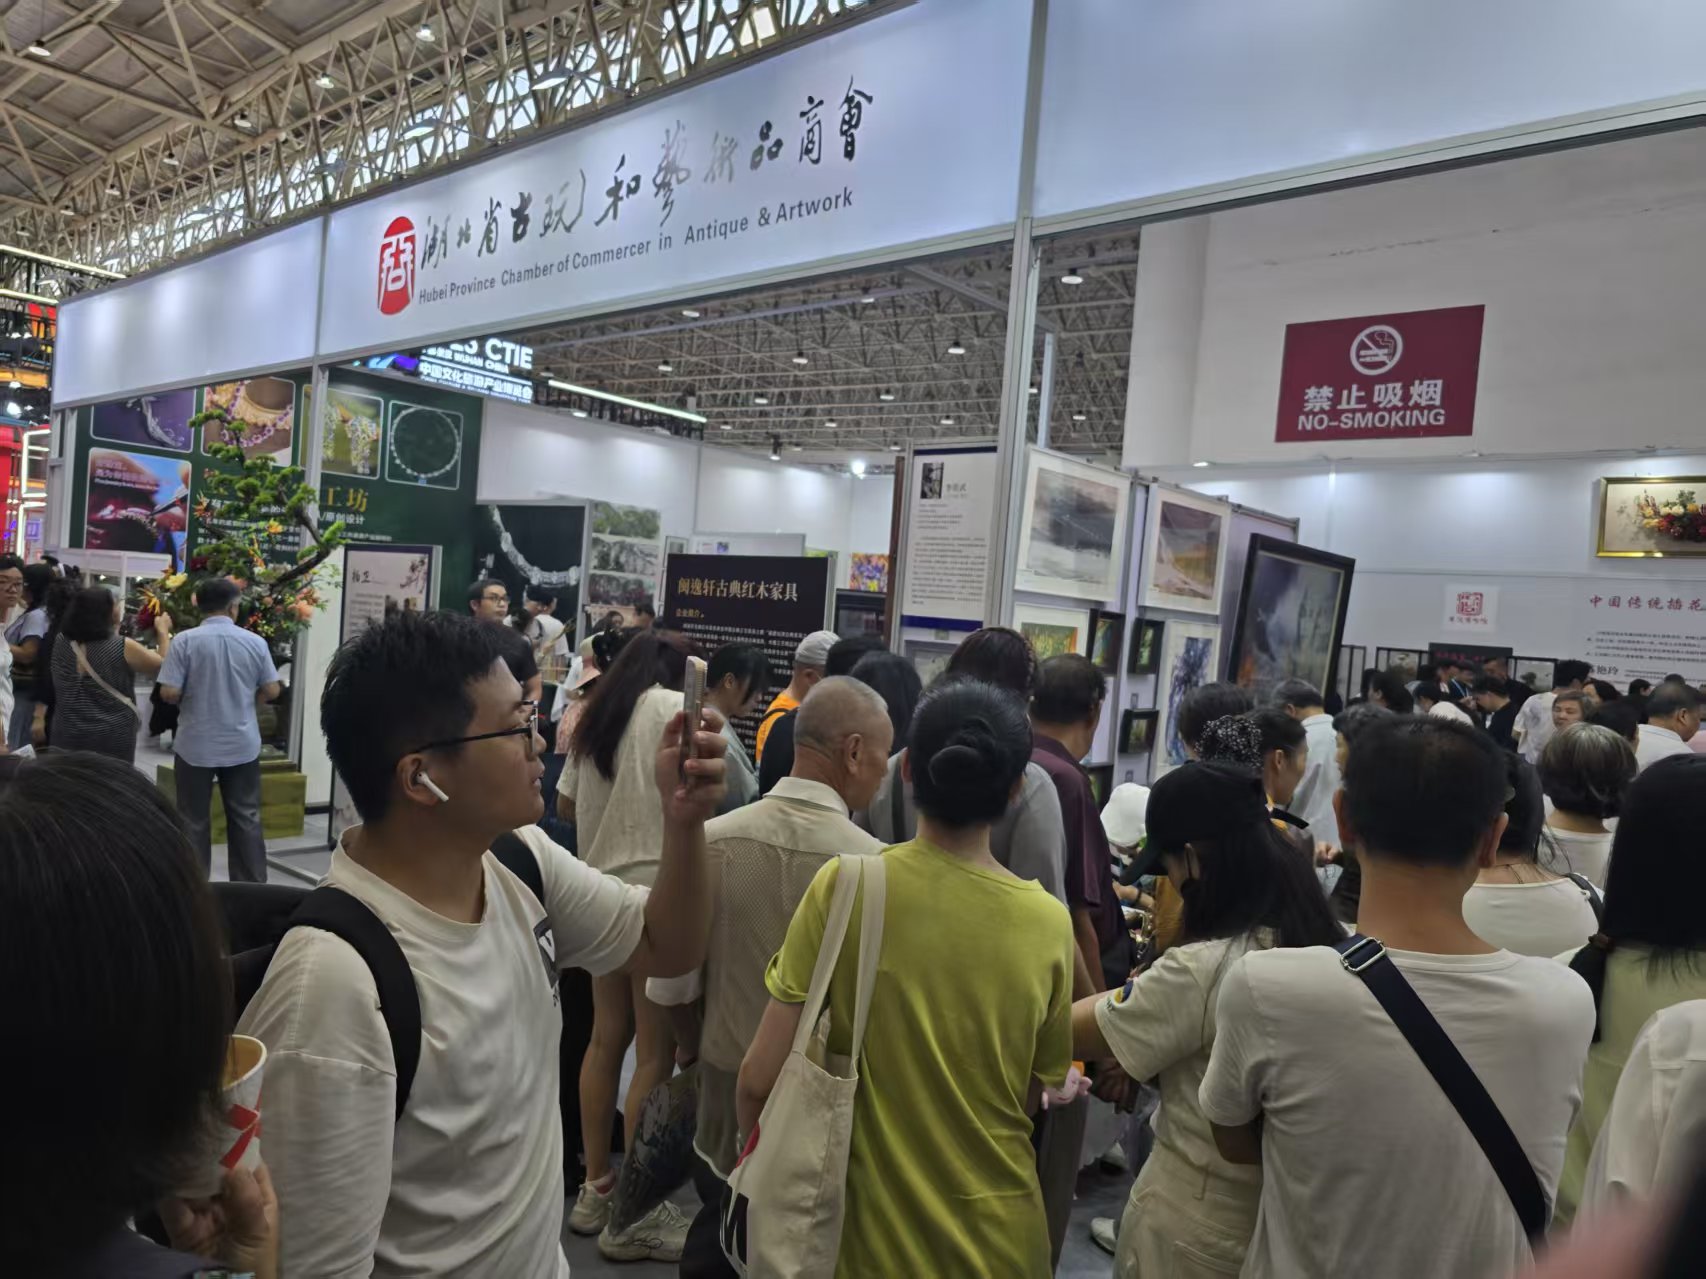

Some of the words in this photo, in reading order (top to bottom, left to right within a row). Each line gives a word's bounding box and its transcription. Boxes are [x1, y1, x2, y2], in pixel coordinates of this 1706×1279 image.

[419, 282, 448, 304] Hubei
[449, 276, 496, 297] Province
[501, 262, 554, 286] Chamber
[557, 254, 570, 273] of
[572, 241, 651, 270] Commercer
[658, 232, 673, 250] in
[684, 216, 749, 245] Antique
[758, 207, 771, 227] &
[775, 186, 854, 225] Artwork
[485, 337, 534, 369] CTIE
[1303, 379, 1444, 413] 禁止吸烟
[1297, 408, 1446, 432] NO-SMOKING
[327, 486, 368, 513] 工坊
[1590, 594, 1706, 611] 中国传统插花
